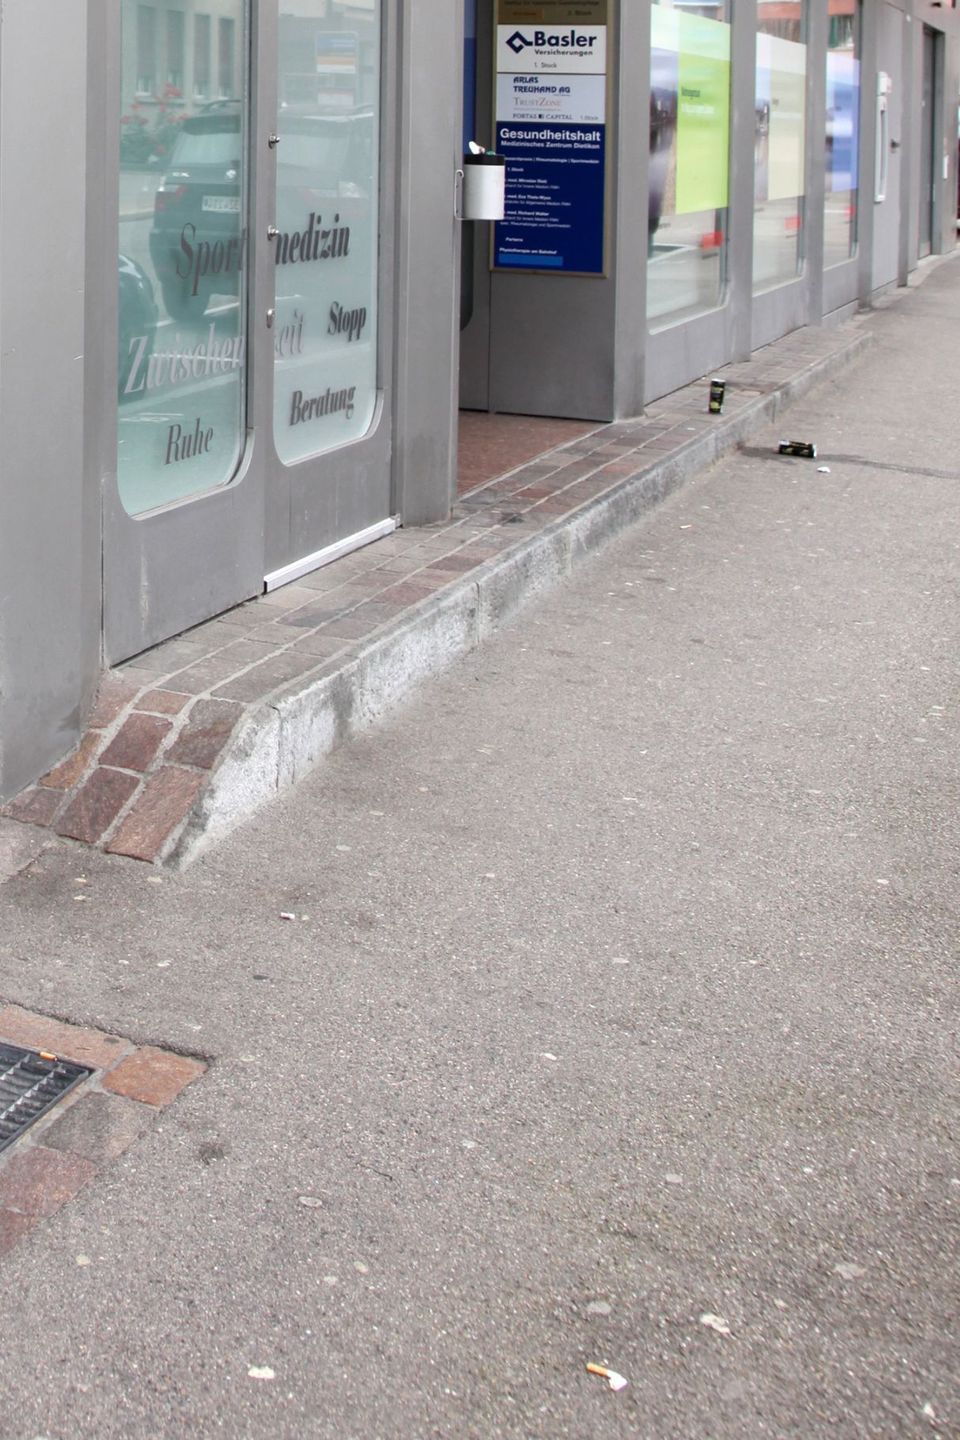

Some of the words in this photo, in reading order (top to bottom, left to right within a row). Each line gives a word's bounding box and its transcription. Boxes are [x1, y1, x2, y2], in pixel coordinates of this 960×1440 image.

[534, 29, 597, 47] Basler
[534, 48, 593, 57] Versicherungen
[500, 128, 601, 142] Gesundheitshalt
[328, 301, 367, 343] Stopp
[289, 386, 356, 427] Beratung
[165, 418, 214, 465] Ruhe
